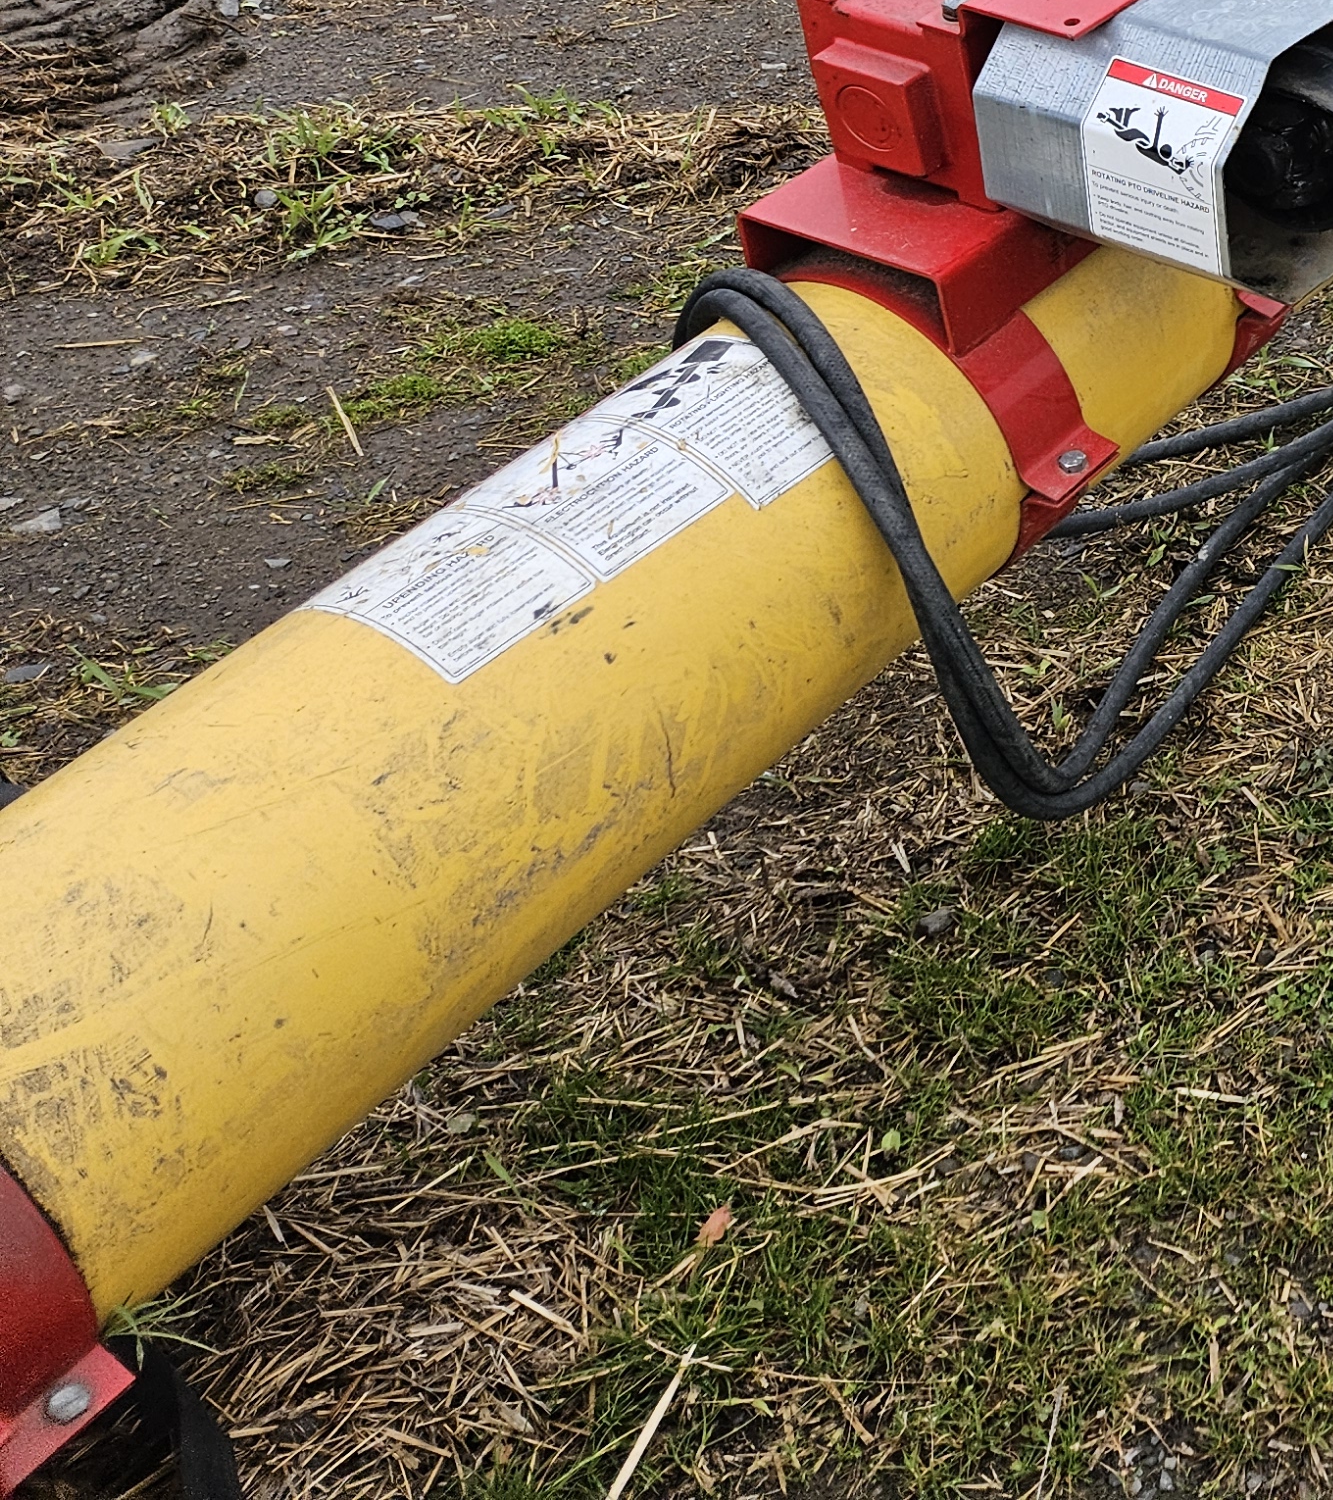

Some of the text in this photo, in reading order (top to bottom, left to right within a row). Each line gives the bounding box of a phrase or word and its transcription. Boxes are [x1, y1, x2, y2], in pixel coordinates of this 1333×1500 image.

[1158, 78, 1208, 103] DANGER
[1092, 169, 1210, 213] ROTATING PTO DRIVELINE HAZARD
[669, 404, 707, 429] ROTATING
[744, 359, 772, 378] HAZAR
[622, 447, 658, 472] HAZARD
[383, 535, 494, 608] UPENDING HAZRD
